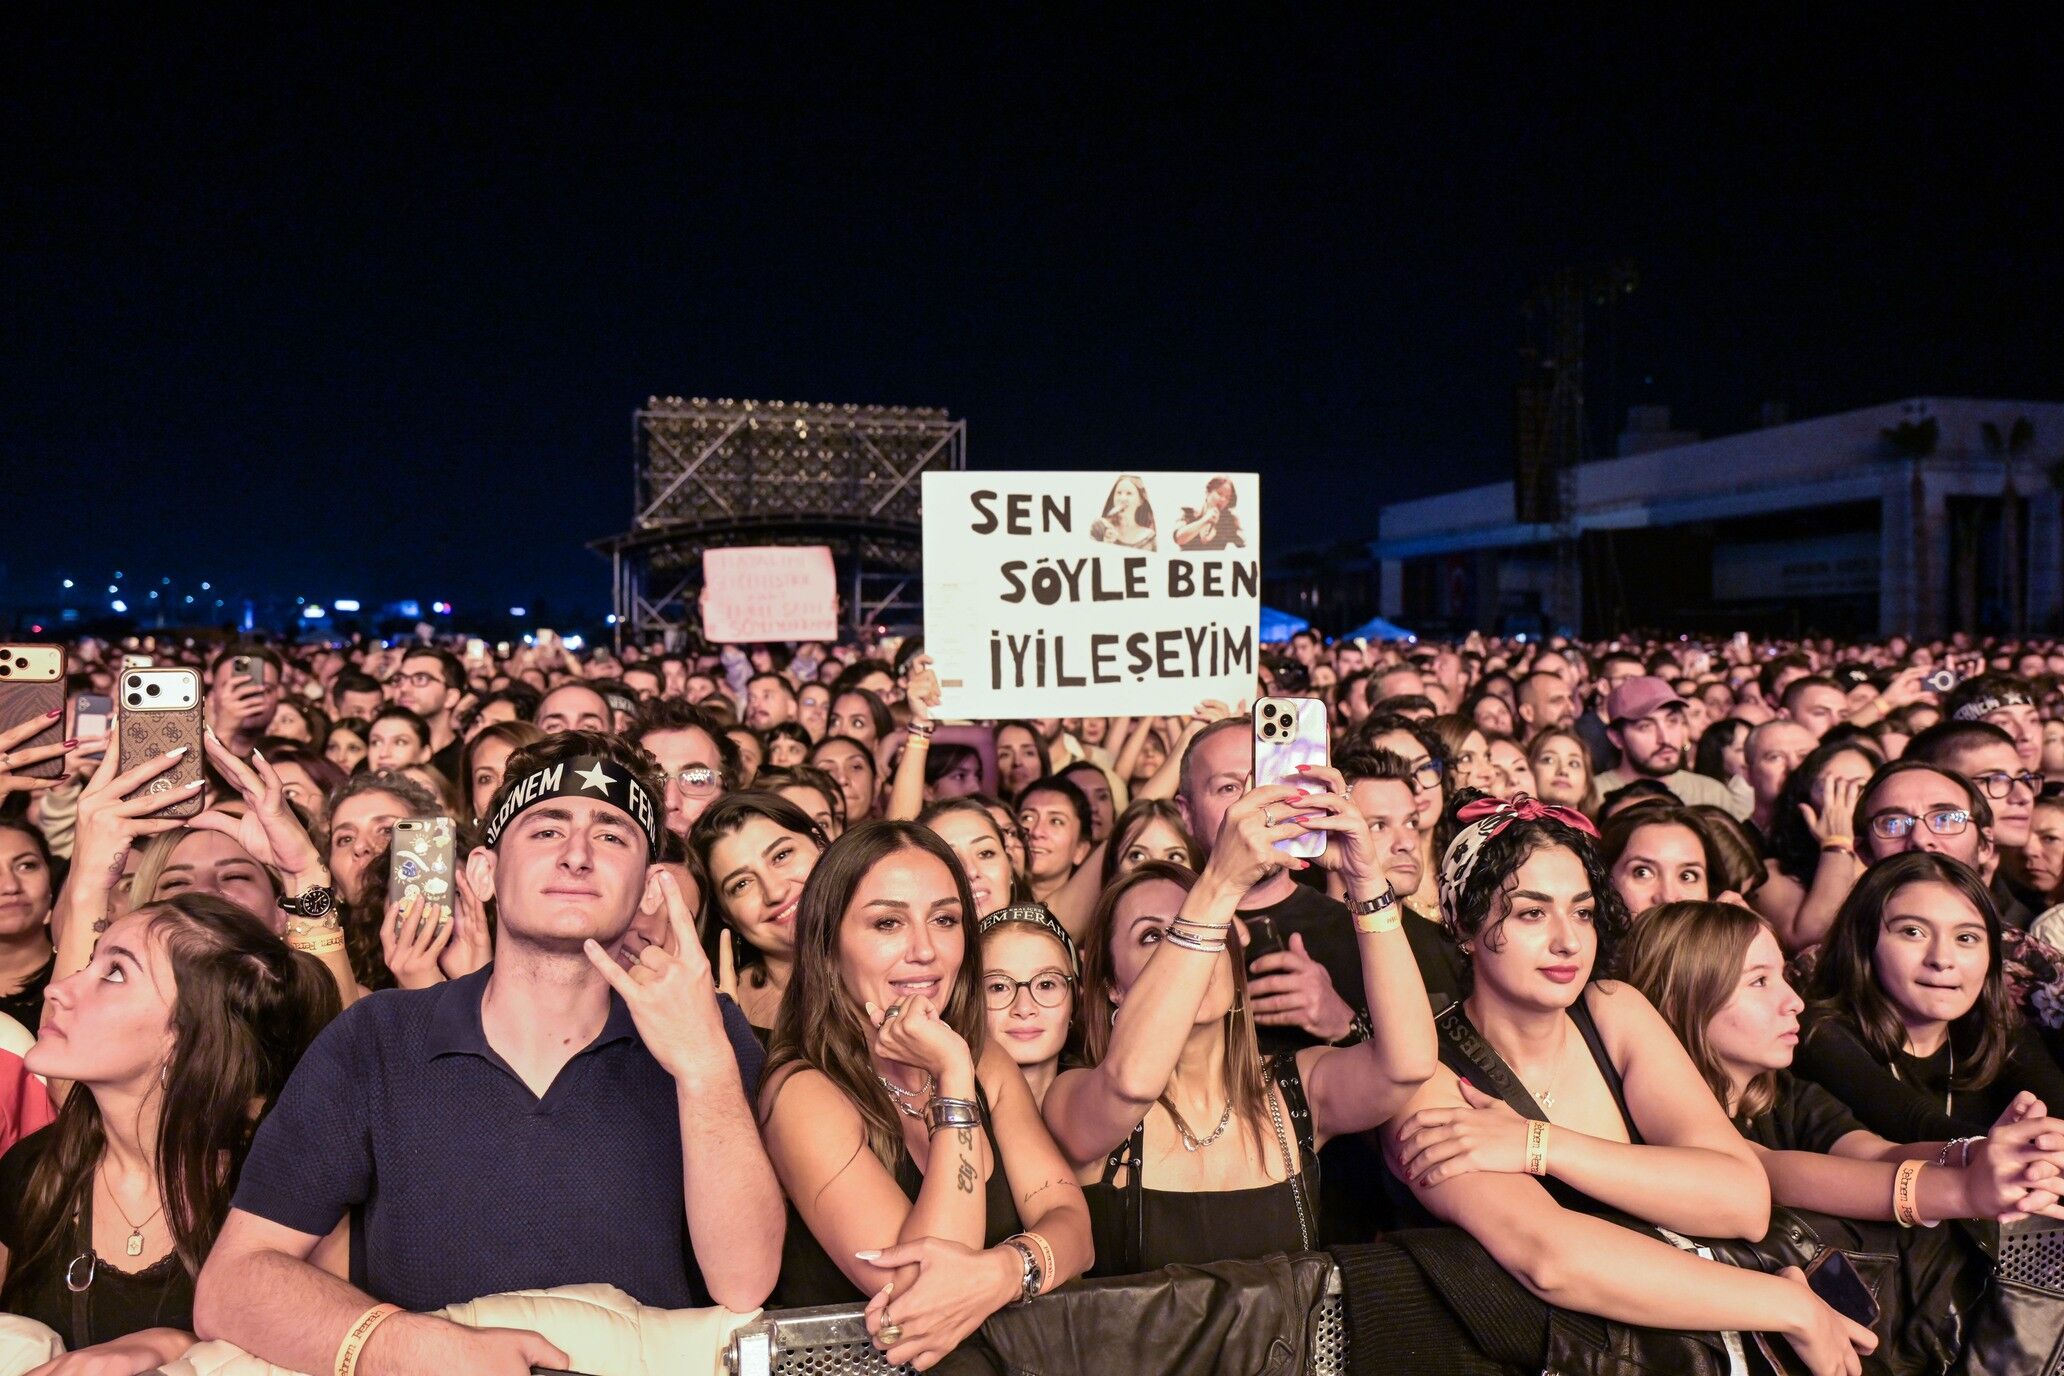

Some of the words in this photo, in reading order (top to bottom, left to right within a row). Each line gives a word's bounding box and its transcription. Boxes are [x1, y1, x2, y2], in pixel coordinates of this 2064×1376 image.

[970, 490, 1072, 535] SEN
[1000, 557, 1149, 605] SÖYLE
[1168, 559, 1257, 598] BEN
[990, 621, 1252, 690] İYİLEŞEYİM
[1013, 910, 1066, 942] FERAH
[957, 1153, 978, 1194] Elif
